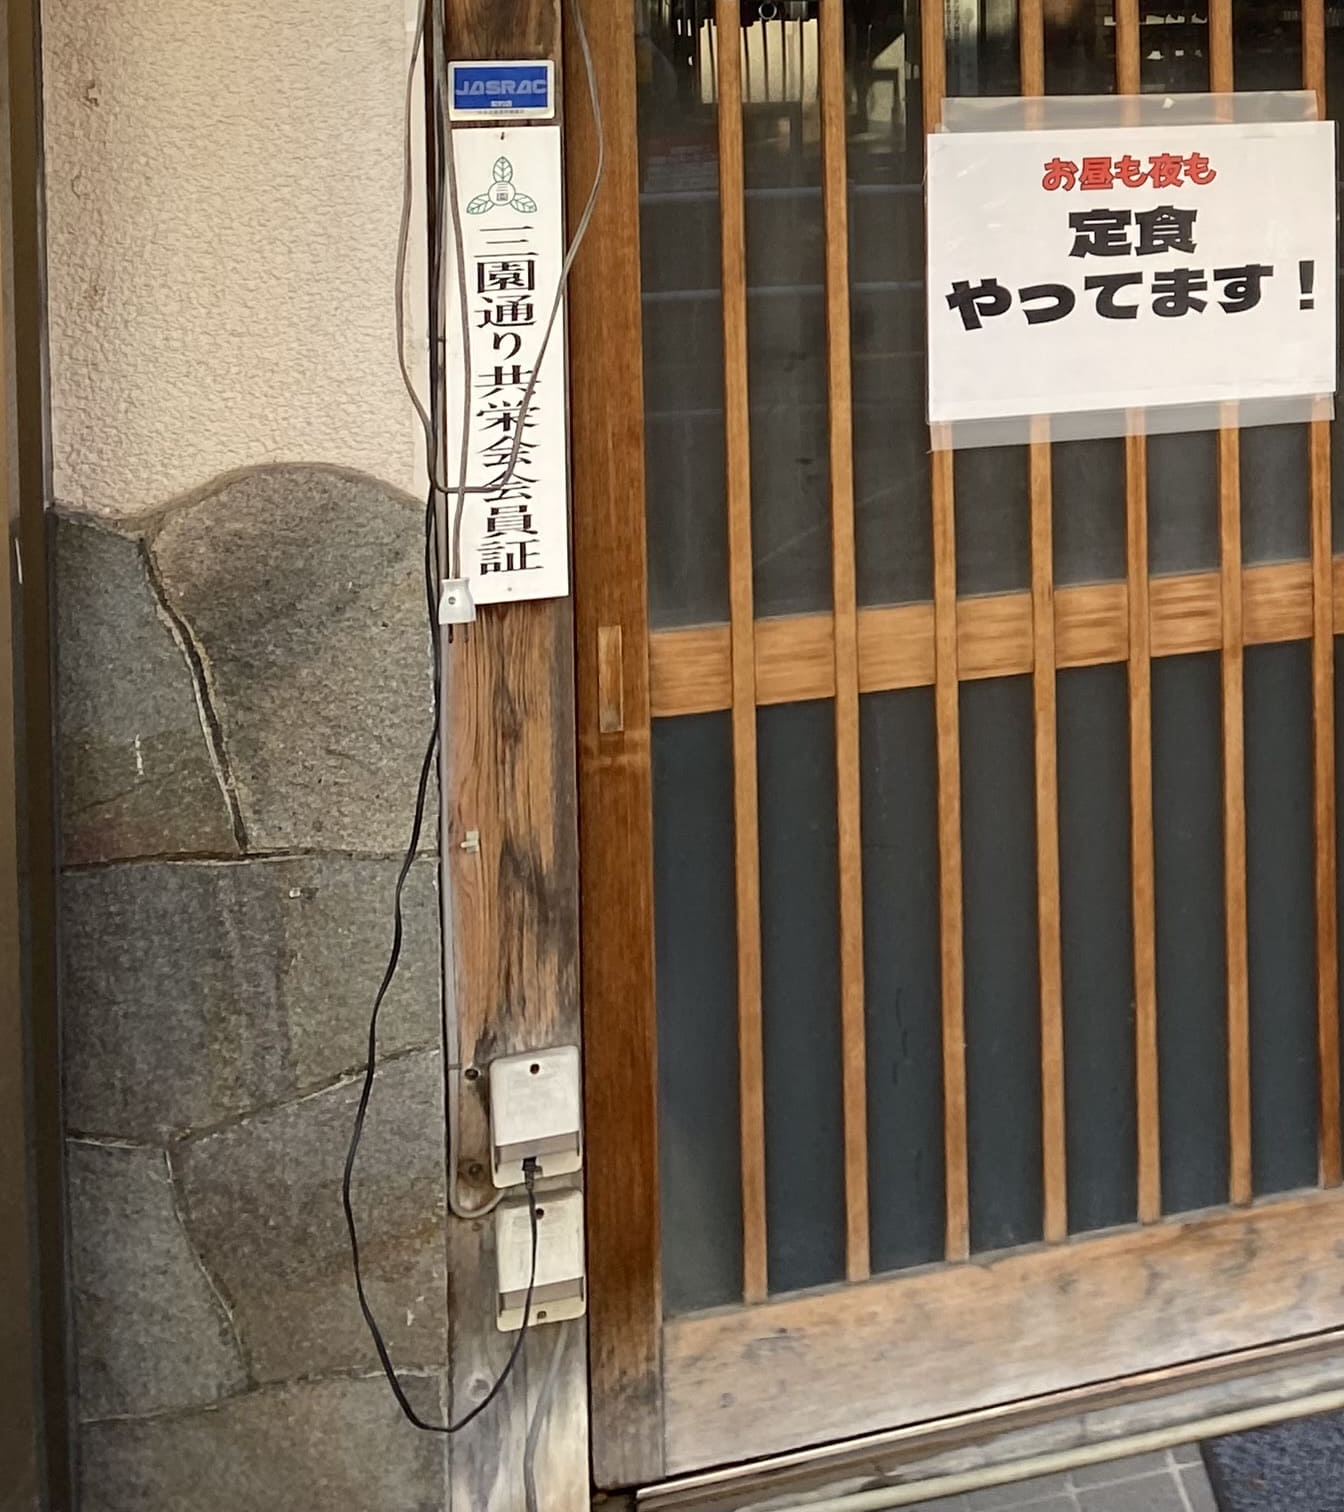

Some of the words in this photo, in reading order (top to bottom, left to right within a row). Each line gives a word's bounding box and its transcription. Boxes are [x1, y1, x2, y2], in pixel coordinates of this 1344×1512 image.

[454, 79, 547, 96] JASRAC
[1041, 152, 1217, 191] お昼も夜も
[1068, 204, 1198, 258] 定食
[471, 225, 544, 576] 三園通り共栄会会員証
